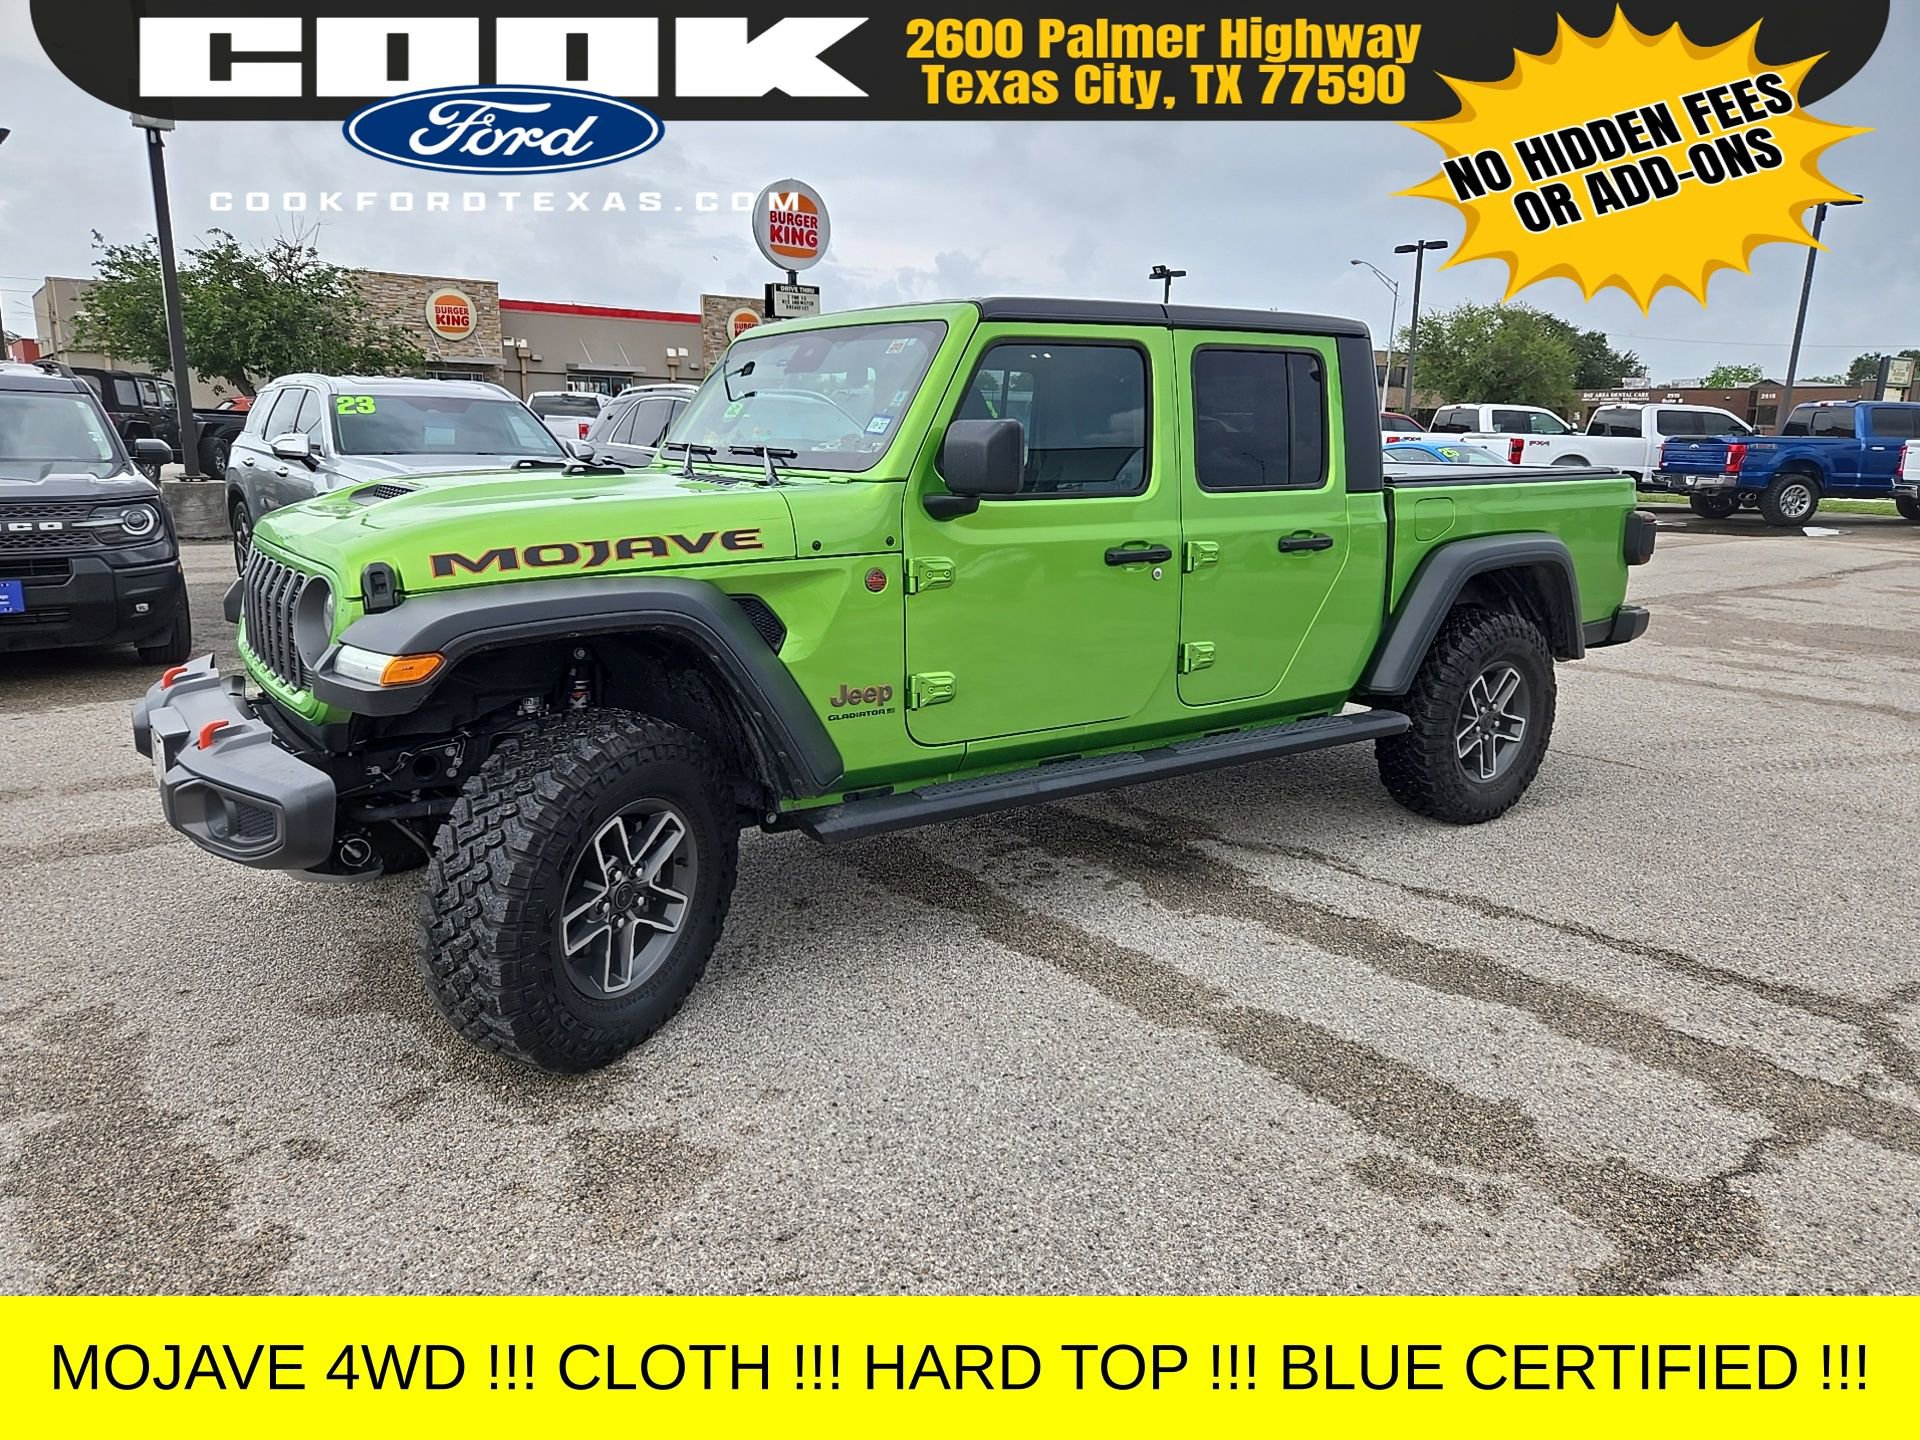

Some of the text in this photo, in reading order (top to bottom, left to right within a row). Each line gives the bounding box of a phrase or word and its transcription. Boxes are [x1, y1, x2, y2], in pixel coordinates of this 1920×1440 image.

[769, 210, 818, 229] BURGER
[769, 224, 818, 247] KING
[434, 305, 469, 316] BURGER
[435, 314, 469, 327] KING
[336, 395, 376, 415] 23
[0, 522, 63, 531] CO
[429, 528, 765, 579] MOJAVE
[830, 684, 893, 707] Jeep
[828, 708, 886, 721] GLADIATOR
